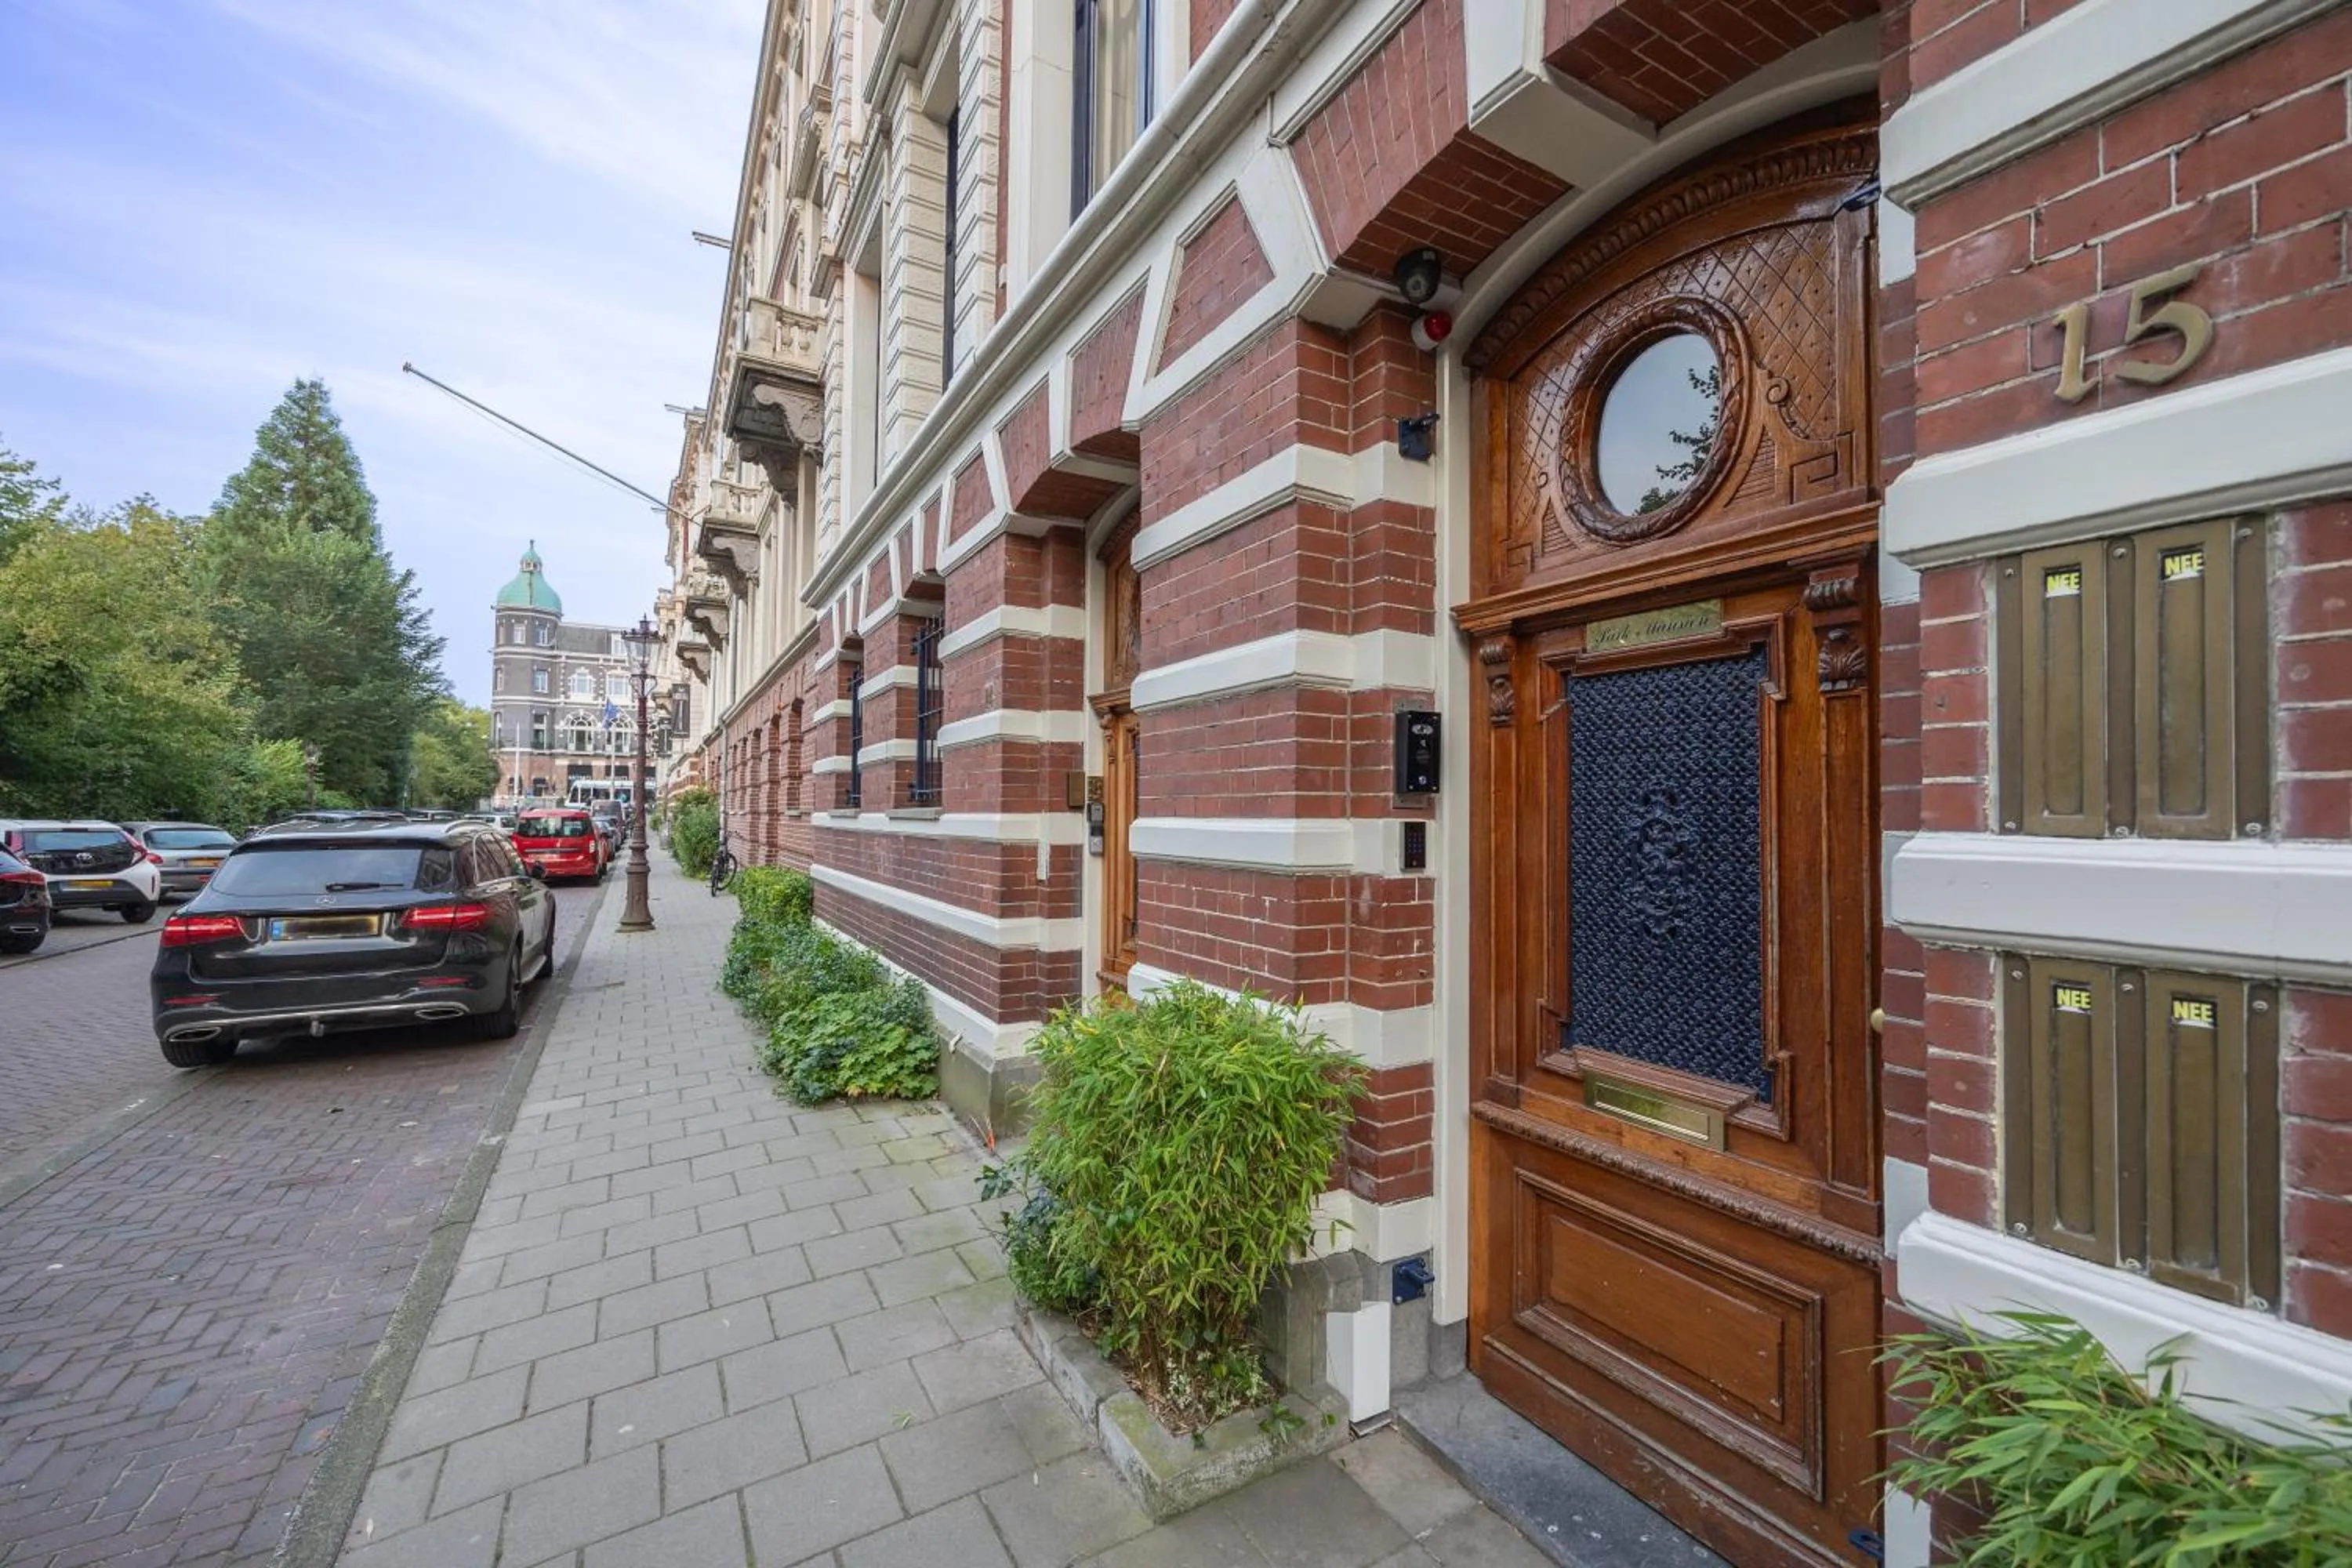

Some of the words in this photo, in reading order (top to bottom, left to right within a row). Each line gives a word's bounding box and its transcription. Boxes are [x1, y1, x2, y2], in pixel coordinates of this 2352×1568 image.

[2052, 260, 2215, 404] 15
[2165, 551, 2205, 577] NEE
[2046, 572, 2082, 592] NEE
[2056, 987, 2092, 1009] NEE
[2172, 1000, 2215, 1022] NEE
